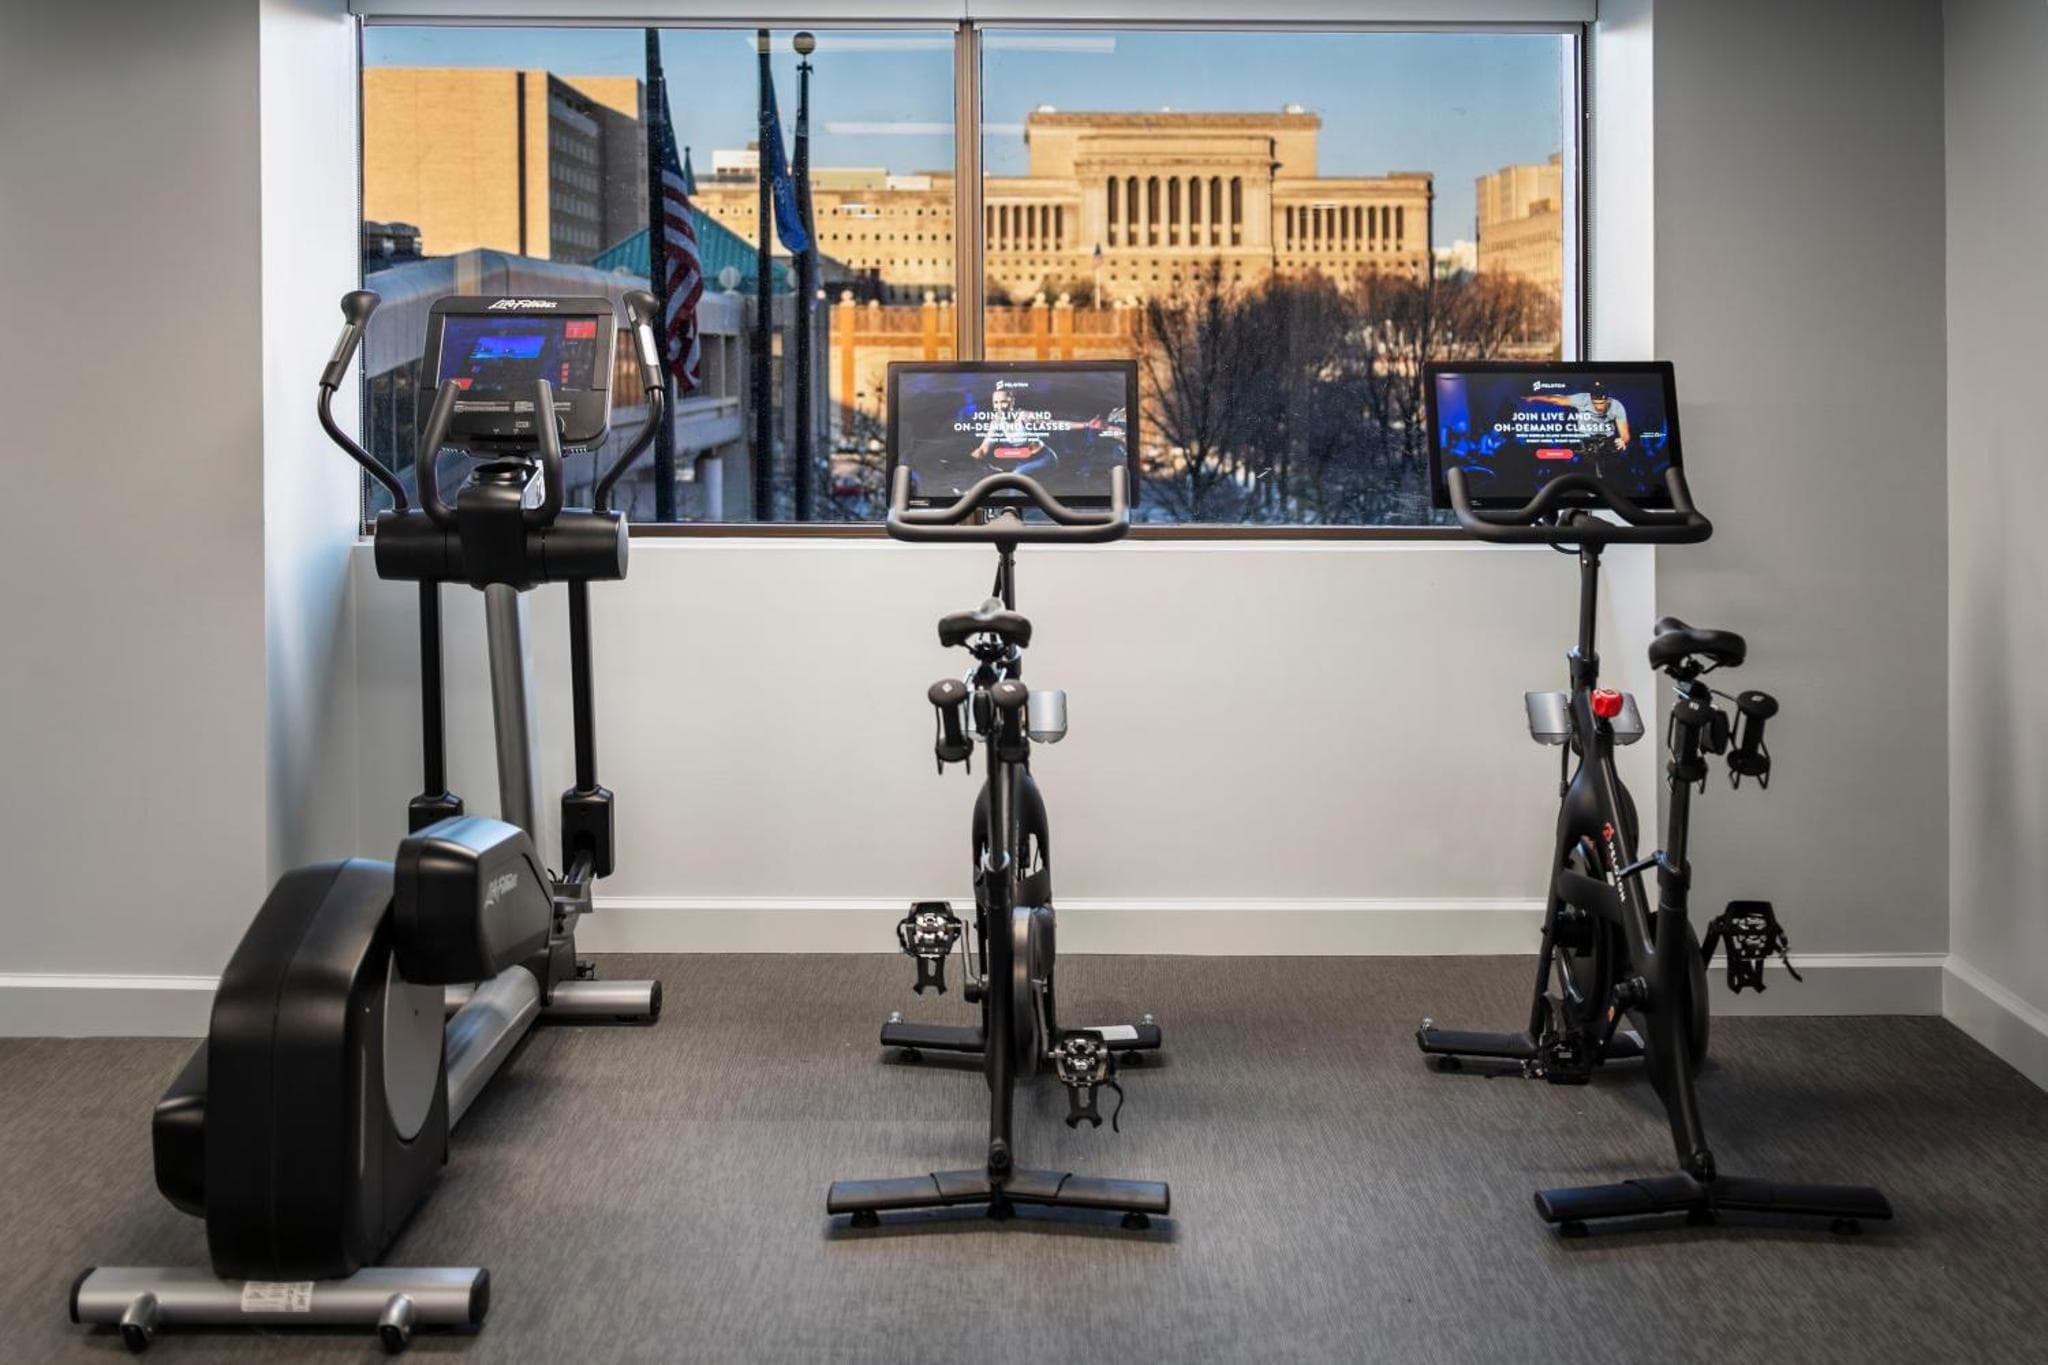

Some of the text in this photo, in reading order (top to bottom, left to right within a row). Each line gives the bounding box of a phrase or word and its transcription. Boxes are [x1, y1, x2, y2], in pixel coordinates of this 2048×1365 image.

[972, 411, 1051, 420] JOIN LIVE AND
[1512, 412, 1591, 421] JOIN LIVE AND
[953, 422, 1071, 431] ON-DEMAND CLASSES
[1494, 423, 1611, 432] ON-DEMAND CLASSES
